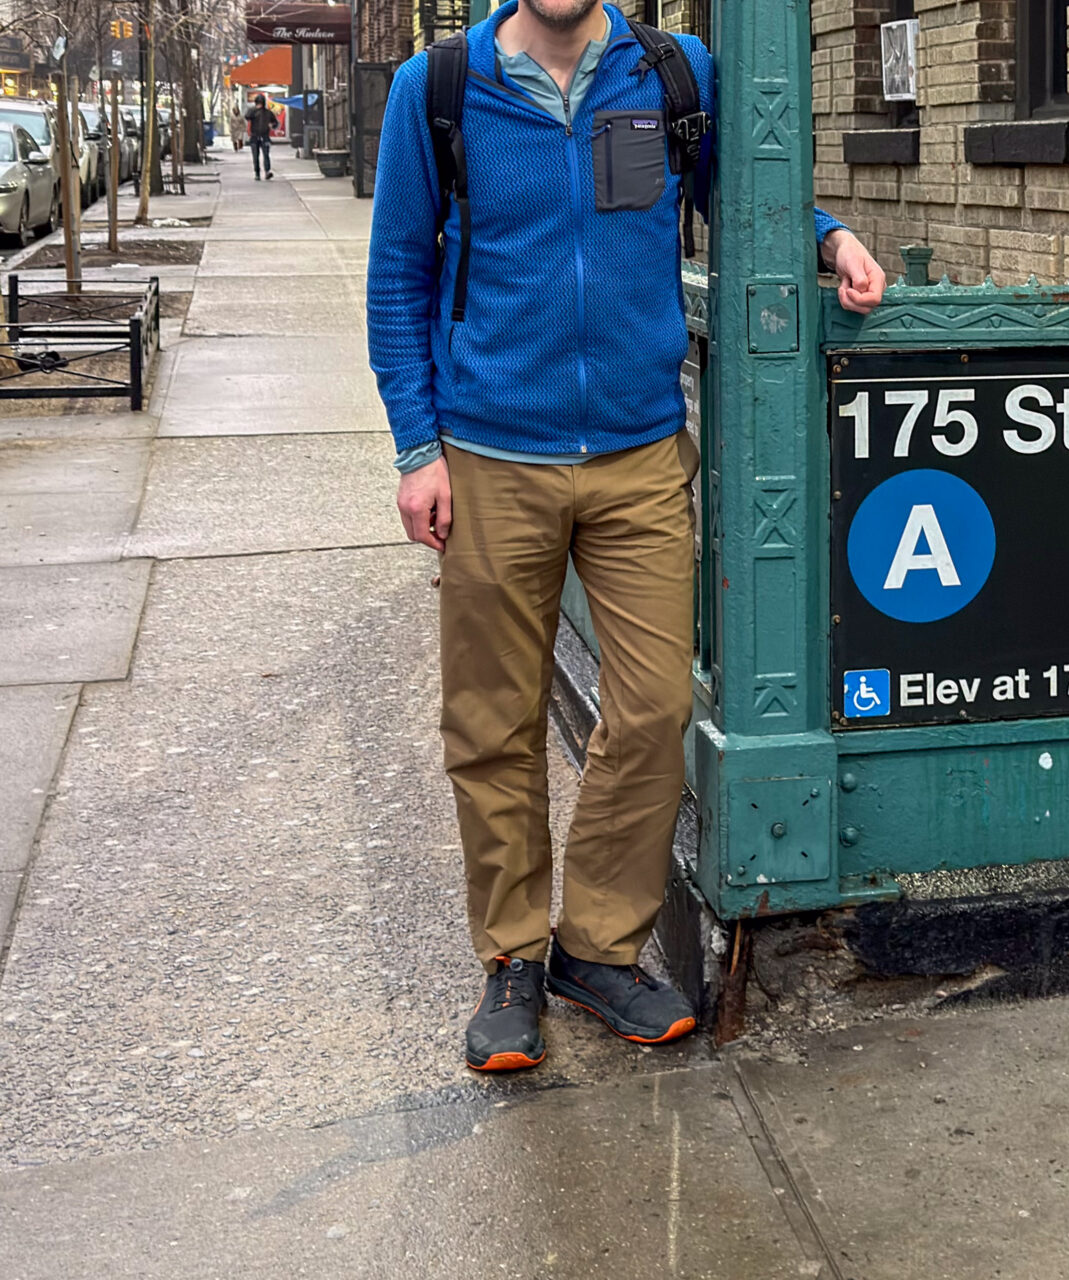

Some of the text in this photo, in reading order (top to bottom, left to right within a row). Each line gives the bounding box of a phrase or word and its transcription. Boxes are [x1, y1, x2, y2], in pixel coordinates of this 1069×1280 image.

[272, 26, 335, 38] The Hudson
[838, 388, 979, 459] 175
[883, 504, 961, 590] A
[899, 672, 980, 707] Elev
[992, 668, 1030, 701] at
